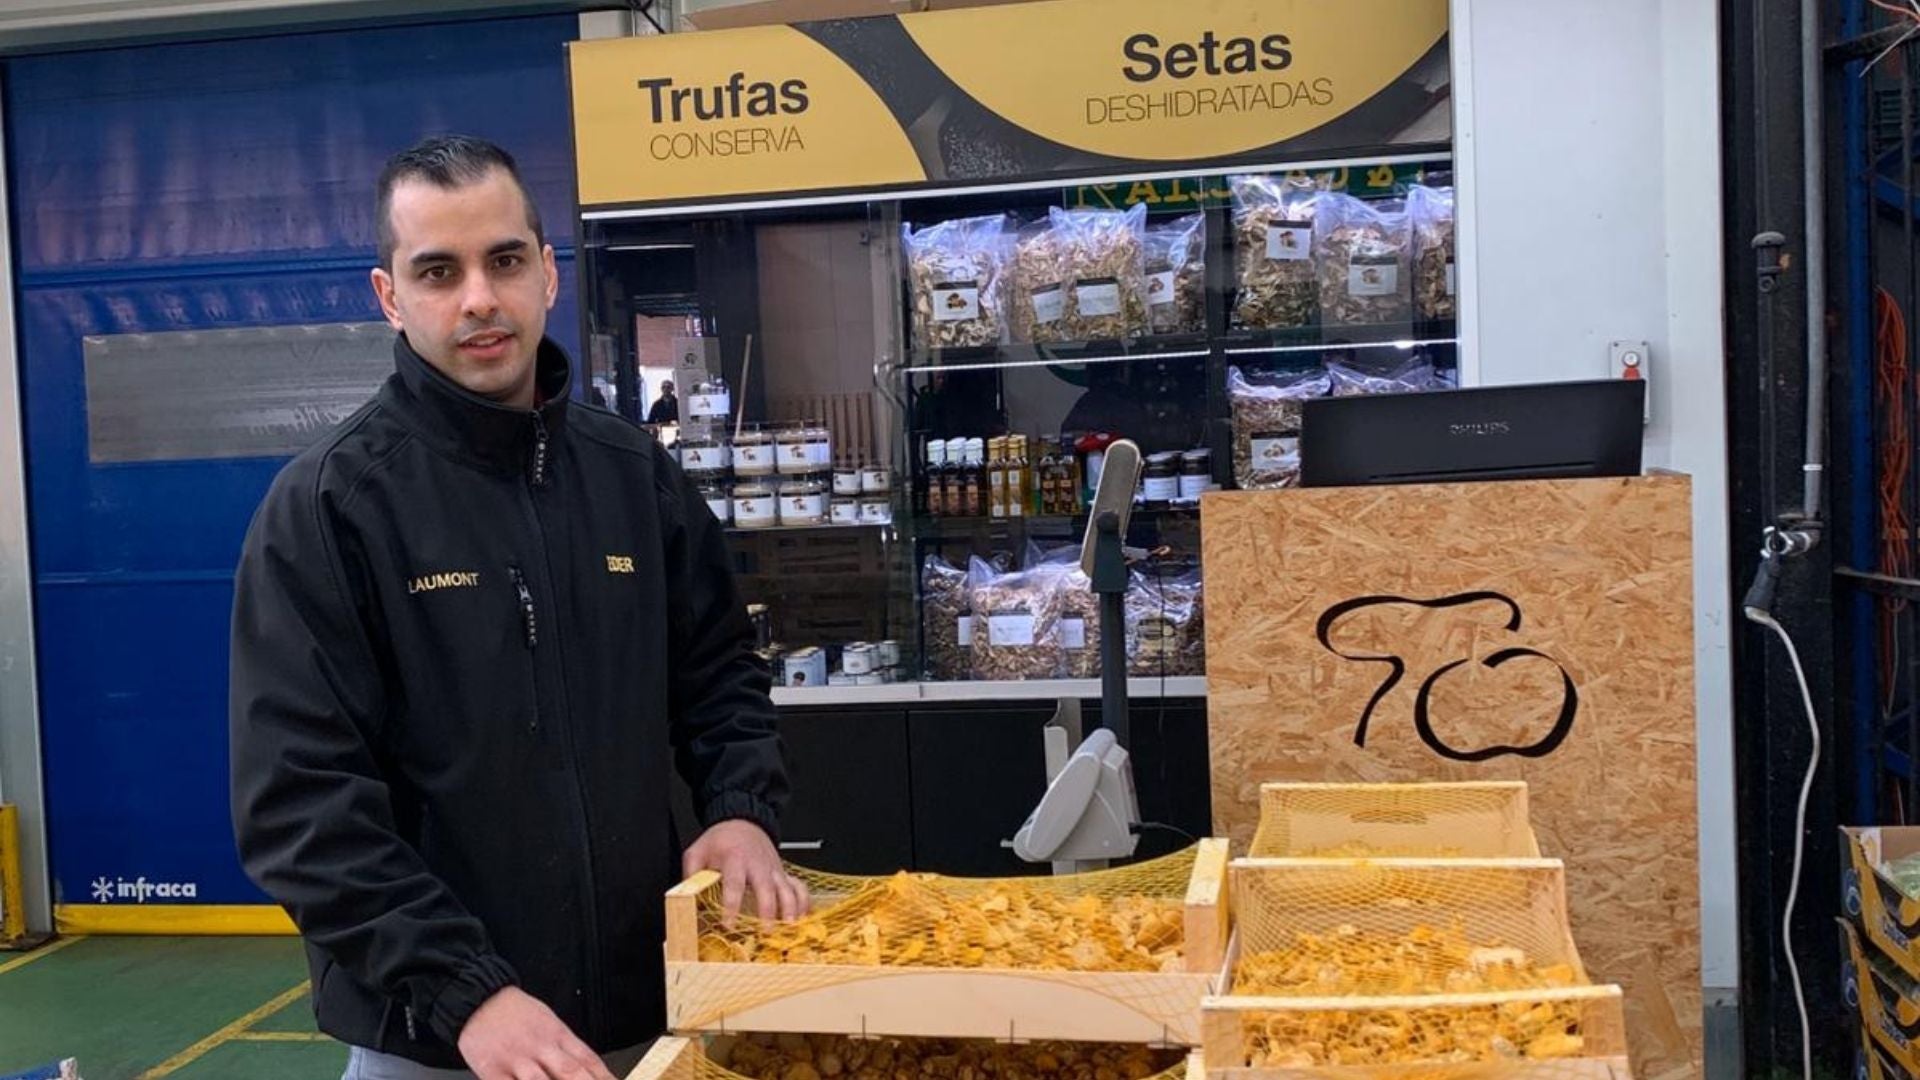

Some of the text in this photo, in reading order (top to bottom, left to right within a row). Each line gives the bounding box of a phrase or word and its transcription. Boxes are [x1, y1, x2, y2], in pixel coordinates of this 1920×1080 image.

[1123, 31, 1293, 82] Setas
[638, 73, 809, 123] Trufas
[1086, 77, 1334, 125] DESHIDRATADAS
[649, 125, 805, 160] CONSERVA
[408, 571, 480, 594] LAUMONT
[117, 876, 197, 903] infraca
